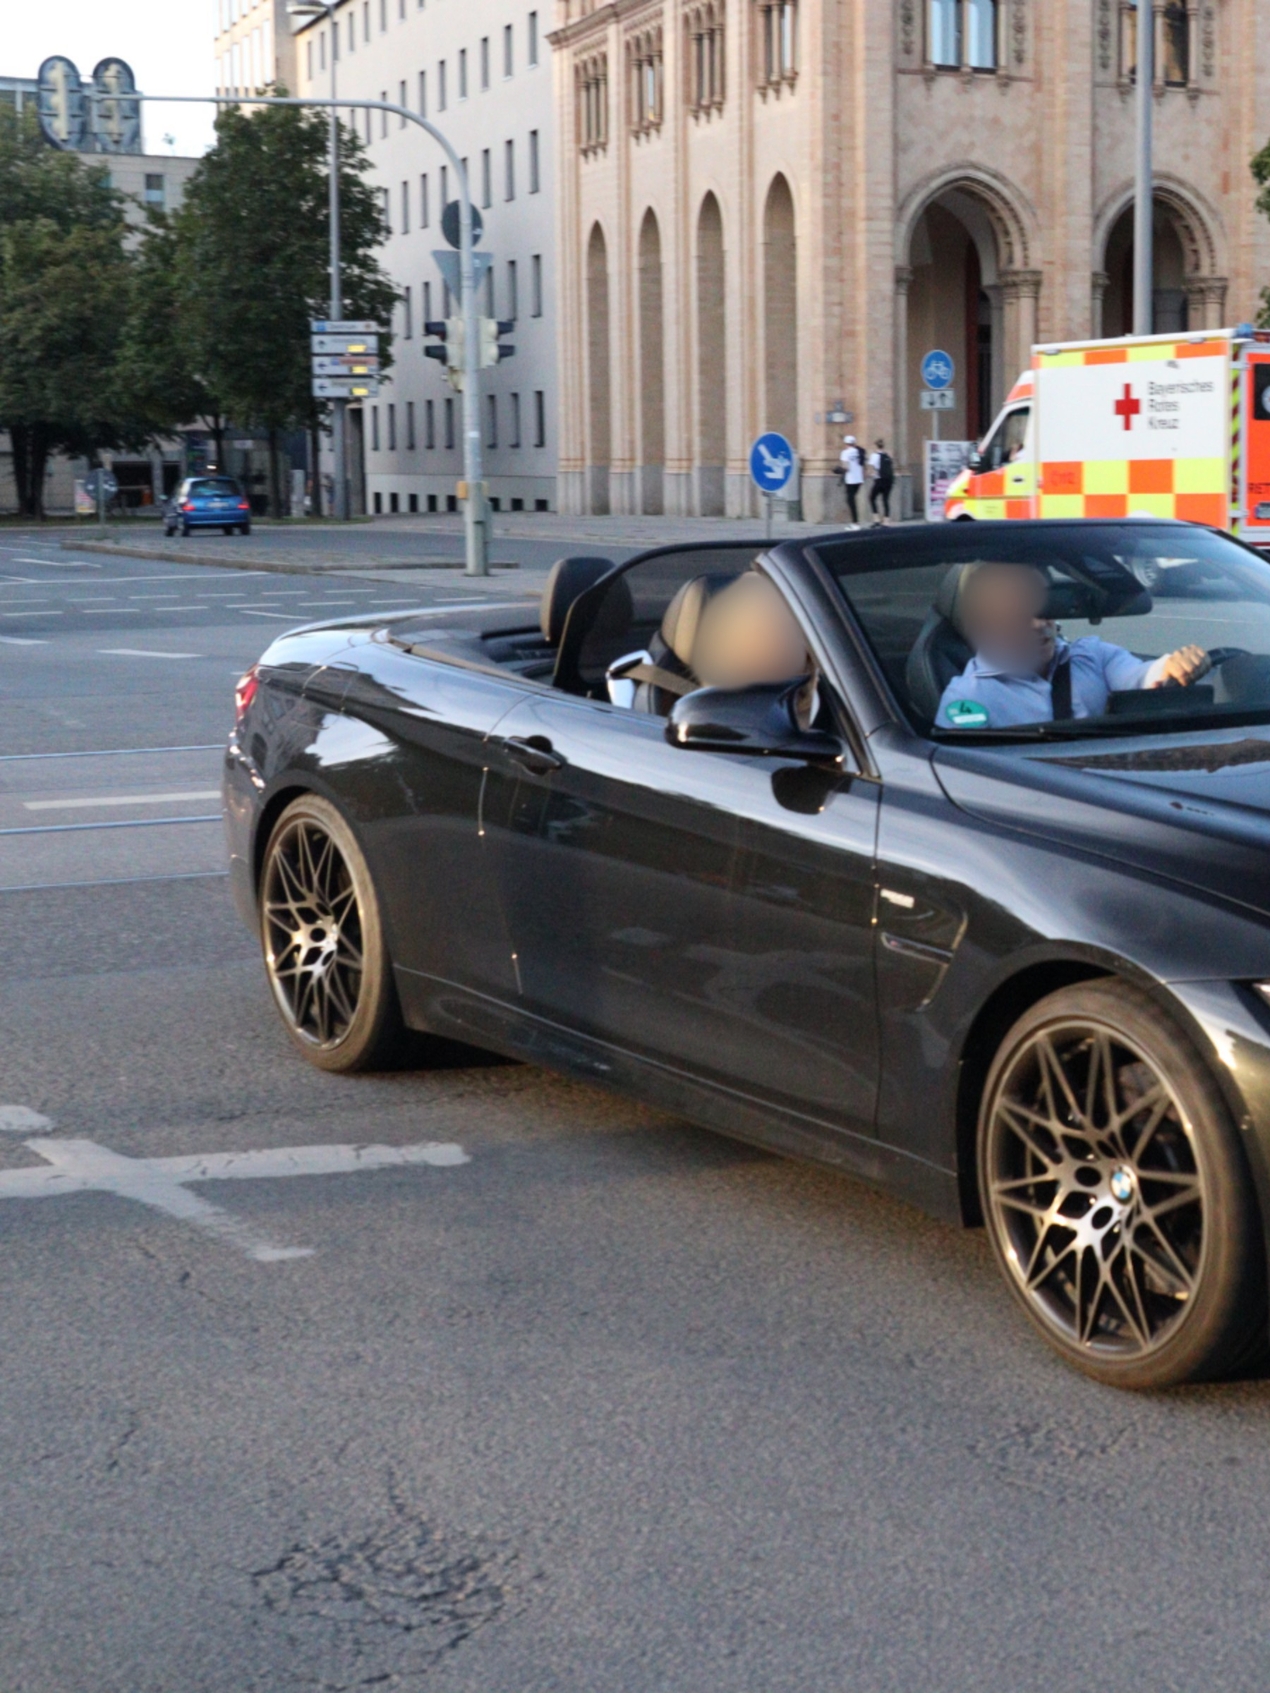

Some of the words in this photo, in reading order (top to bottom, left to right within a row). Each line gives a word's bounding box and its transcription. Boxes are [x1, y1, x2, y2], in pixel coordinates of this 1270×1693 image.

[1148, 380, 1214, 397] Bayerisches
[1148, 399, 1179, 412] Rotes
[1148, 417, 1179, 430] Kreuz
